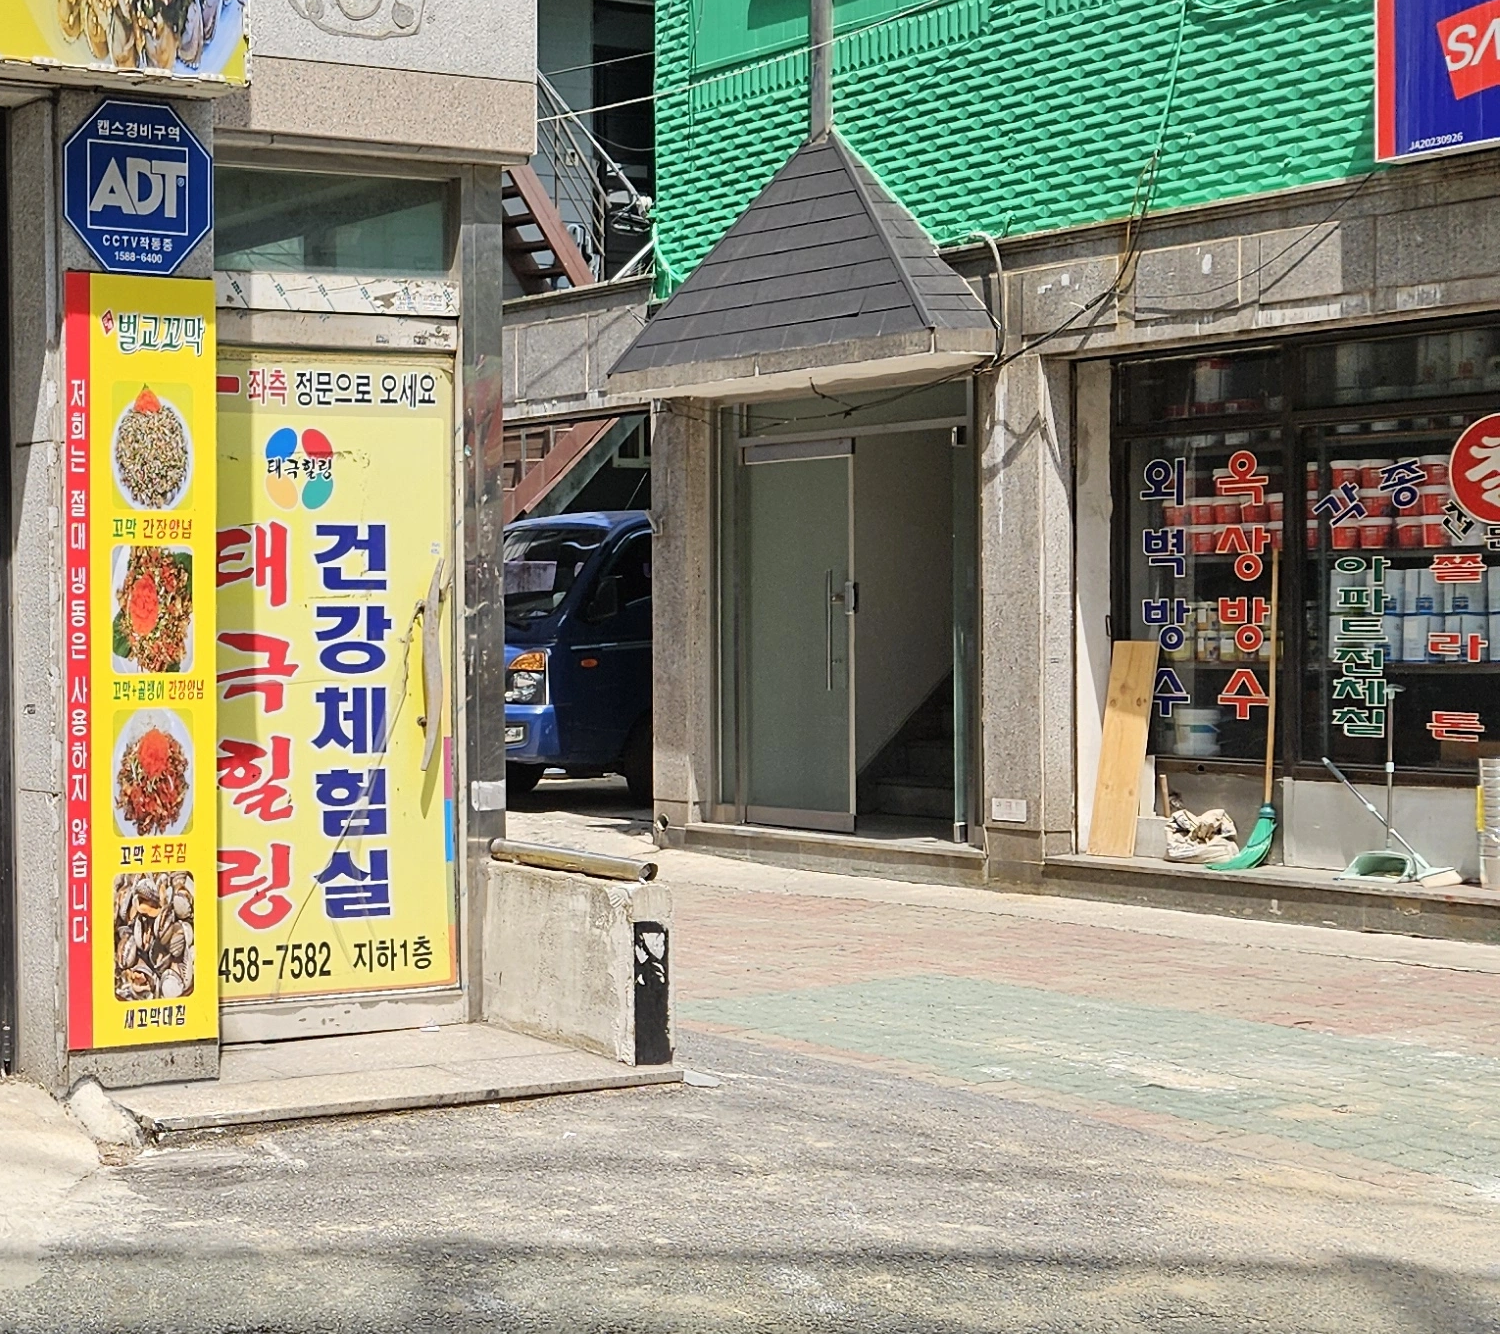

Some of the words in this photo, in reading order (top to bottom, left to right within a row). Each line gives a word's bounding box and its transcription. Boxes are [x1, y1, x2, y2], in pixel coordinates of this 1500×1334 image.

[97, 119, 181, 142] 캡스경비구역
[1409, 131, 1464, 151] JA20230926
[89, 156, 187, 218] ADT
[102, 234, 173, 252] CCTV작동중
[114, 250, 164, 264] 1588-6400
[116, 313, 206, 358] 벌교꼬막
[248, 368, 288, 405] 좌측
[295, 371, 373, 406] 정문으로
[380, 373, 437, 408] 오세요
[70, 379, 86, 473] 저희는
[266, 457, 333, 480] 태극힐링
[1313, 458, 1428, 528] 각종
[70, 490, 86, 551] 절대
[112, 518, 137, 539] 꼬막
[142, 518, 193, 540] 간장양념
[1140, 457, 1192, 718] 외벽방수
[1213, 450, 1271, 720] 옥상방수
[71, 676, 88, 802] 사용하지
[216, 521, 299, 930] 태극힐링
[311, 524, 393, 919] 건강체험실
[120, 845, 145, 866] 꼬막
[150, 842, 188, 864] 초무침
[71, 818, 90, 944] 않습니다
[352, 935, 433, 974] 지하1층
[124, 1004, 187, 1030] 새꼬막데침
